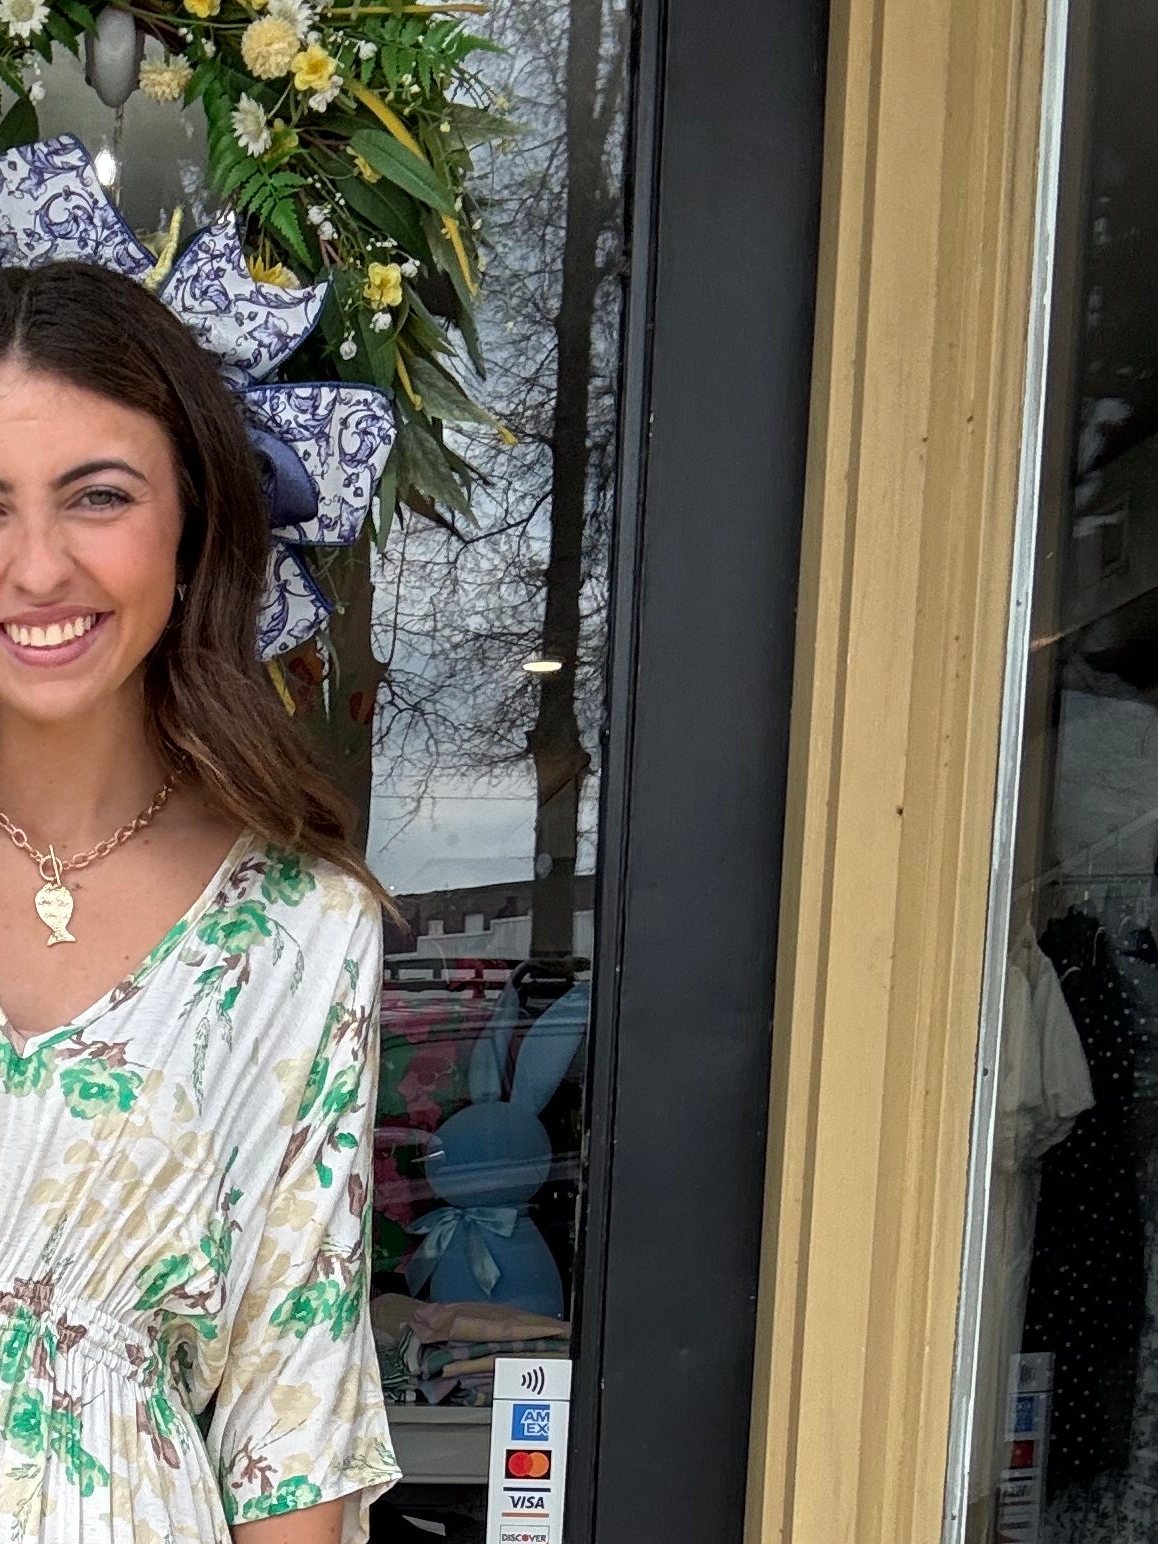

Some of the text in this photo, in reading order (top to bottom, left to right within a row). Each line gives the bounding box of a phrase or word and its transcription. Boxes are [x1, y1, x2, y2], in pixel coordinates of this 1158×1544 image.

[523, 1411, 550, 1423] AM
[509, 1495, 545, 1509] VISA
[501, 1533, 547, 1543] DISCOVER
